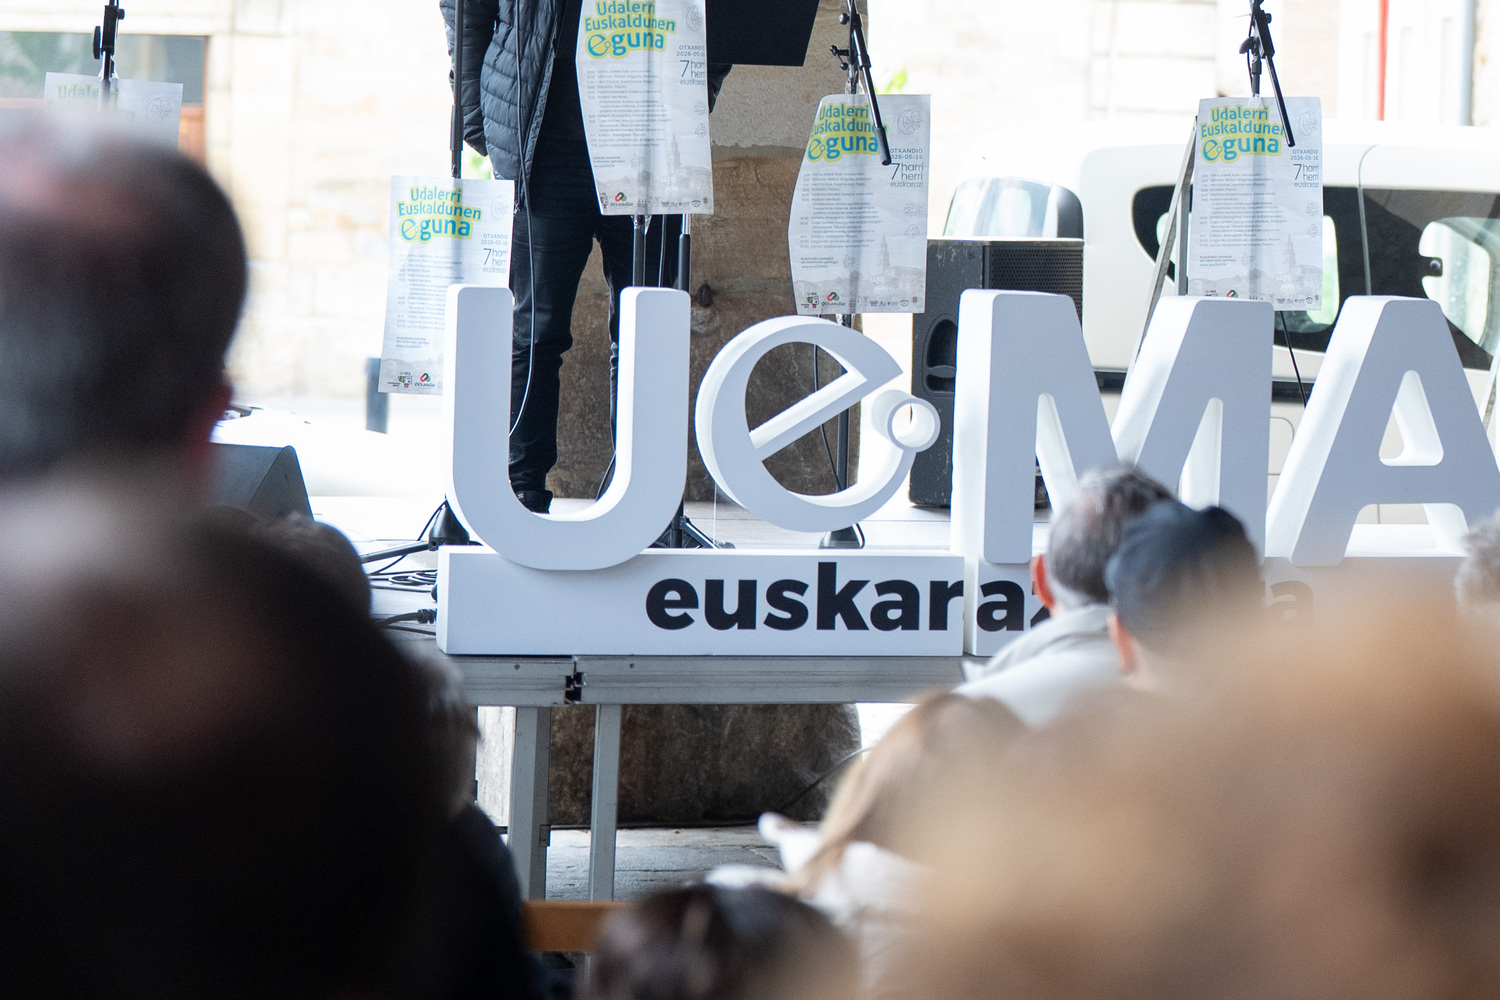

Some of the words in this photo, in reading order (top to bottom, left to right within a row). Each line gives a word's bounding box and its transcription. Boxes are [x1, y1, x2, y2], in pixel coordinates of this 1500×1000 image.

[597, 0, 655, 16] Udalerri
[585, 14, 675, 31] Euskaldunen
[588, 32, 664, 56] eguna
[680, 60, 690, 78] 7
[820, 104, 869, 120] Udalerri
[1212, 107, 1268, 122] Udalerri
[808, 135, 879, 160] eguna
[1203, 138, 1279, 161] eguna
[890, 162, 900, 180] 7
[901, 162, 924, 172] harri
[901, 171, 924, 181] herri
[1293, 163, 1302, 181] 7
[410, 187, 461, 202] Udalerri
[398, 202, 481, 219] Euskaldunen
[401, 219, 470, 241] eguna
[483, 248, 492, 265] 7
